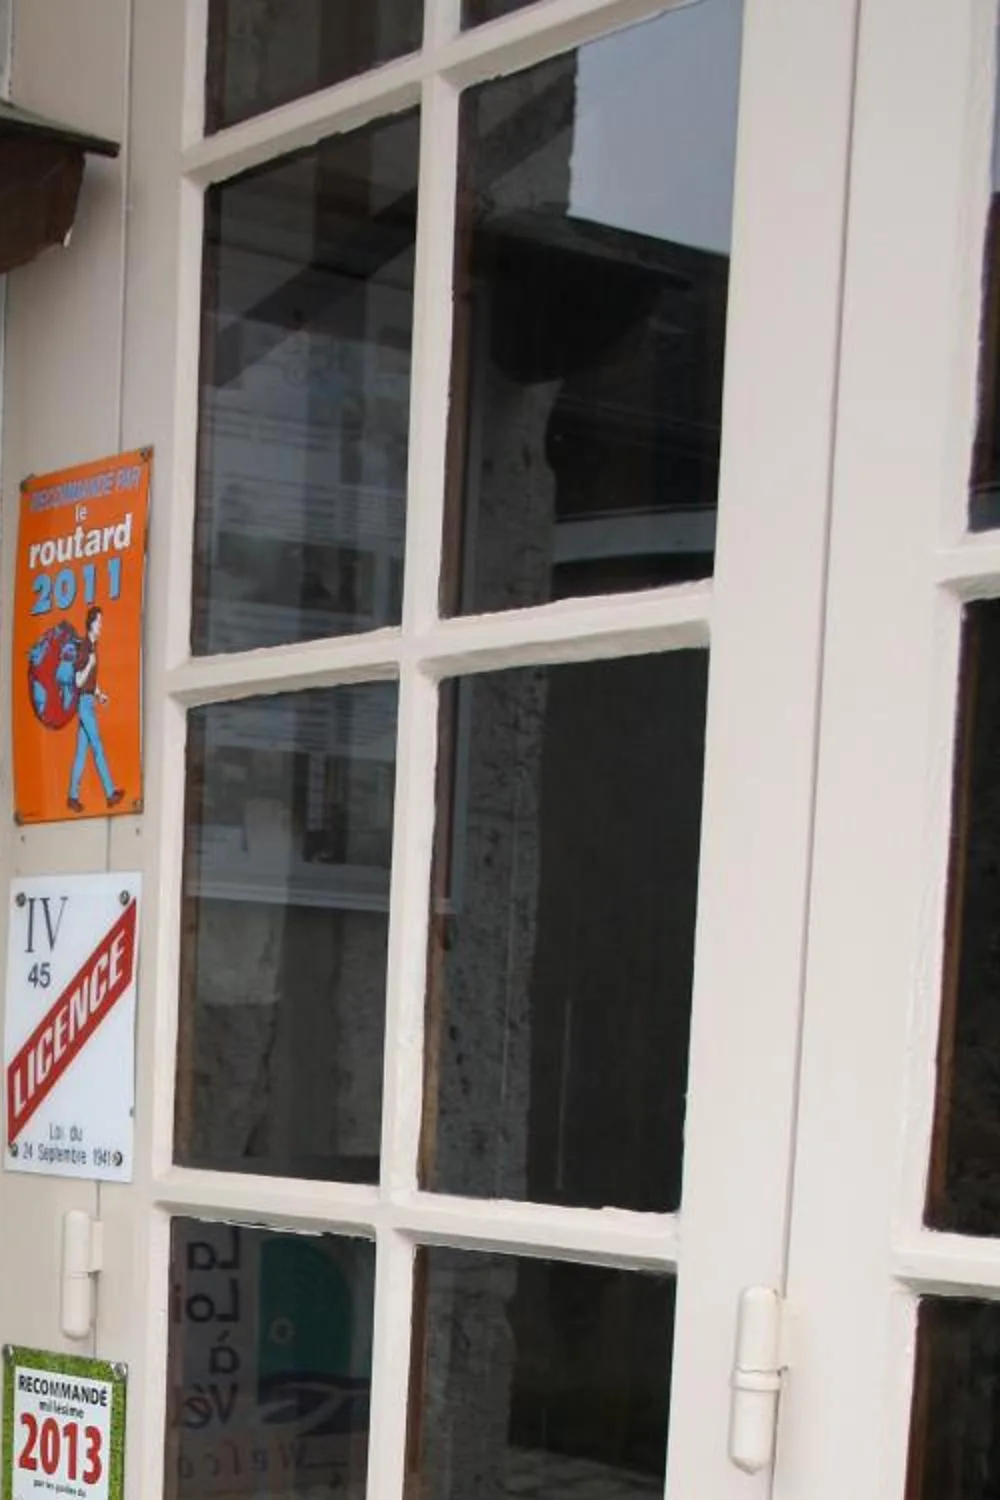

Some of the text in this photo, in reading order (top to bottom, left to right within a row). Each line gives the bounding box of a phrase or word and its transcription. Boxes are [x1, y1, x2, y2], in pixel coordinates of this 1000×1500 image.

[28, 511, 133, 570] routard
[75, 503, 89, 522] le
[29, 557, 122, 616] 2011
[25, 896, 69, 953] IV
[28, 962, 51, 989] 45
[13, 929, 125, 1119] LICENCE
[37, 1143, 88, 1165] Septembre
[69, 1125, 83, 1142] du
[18, 1411, 103, 1485] 2013
